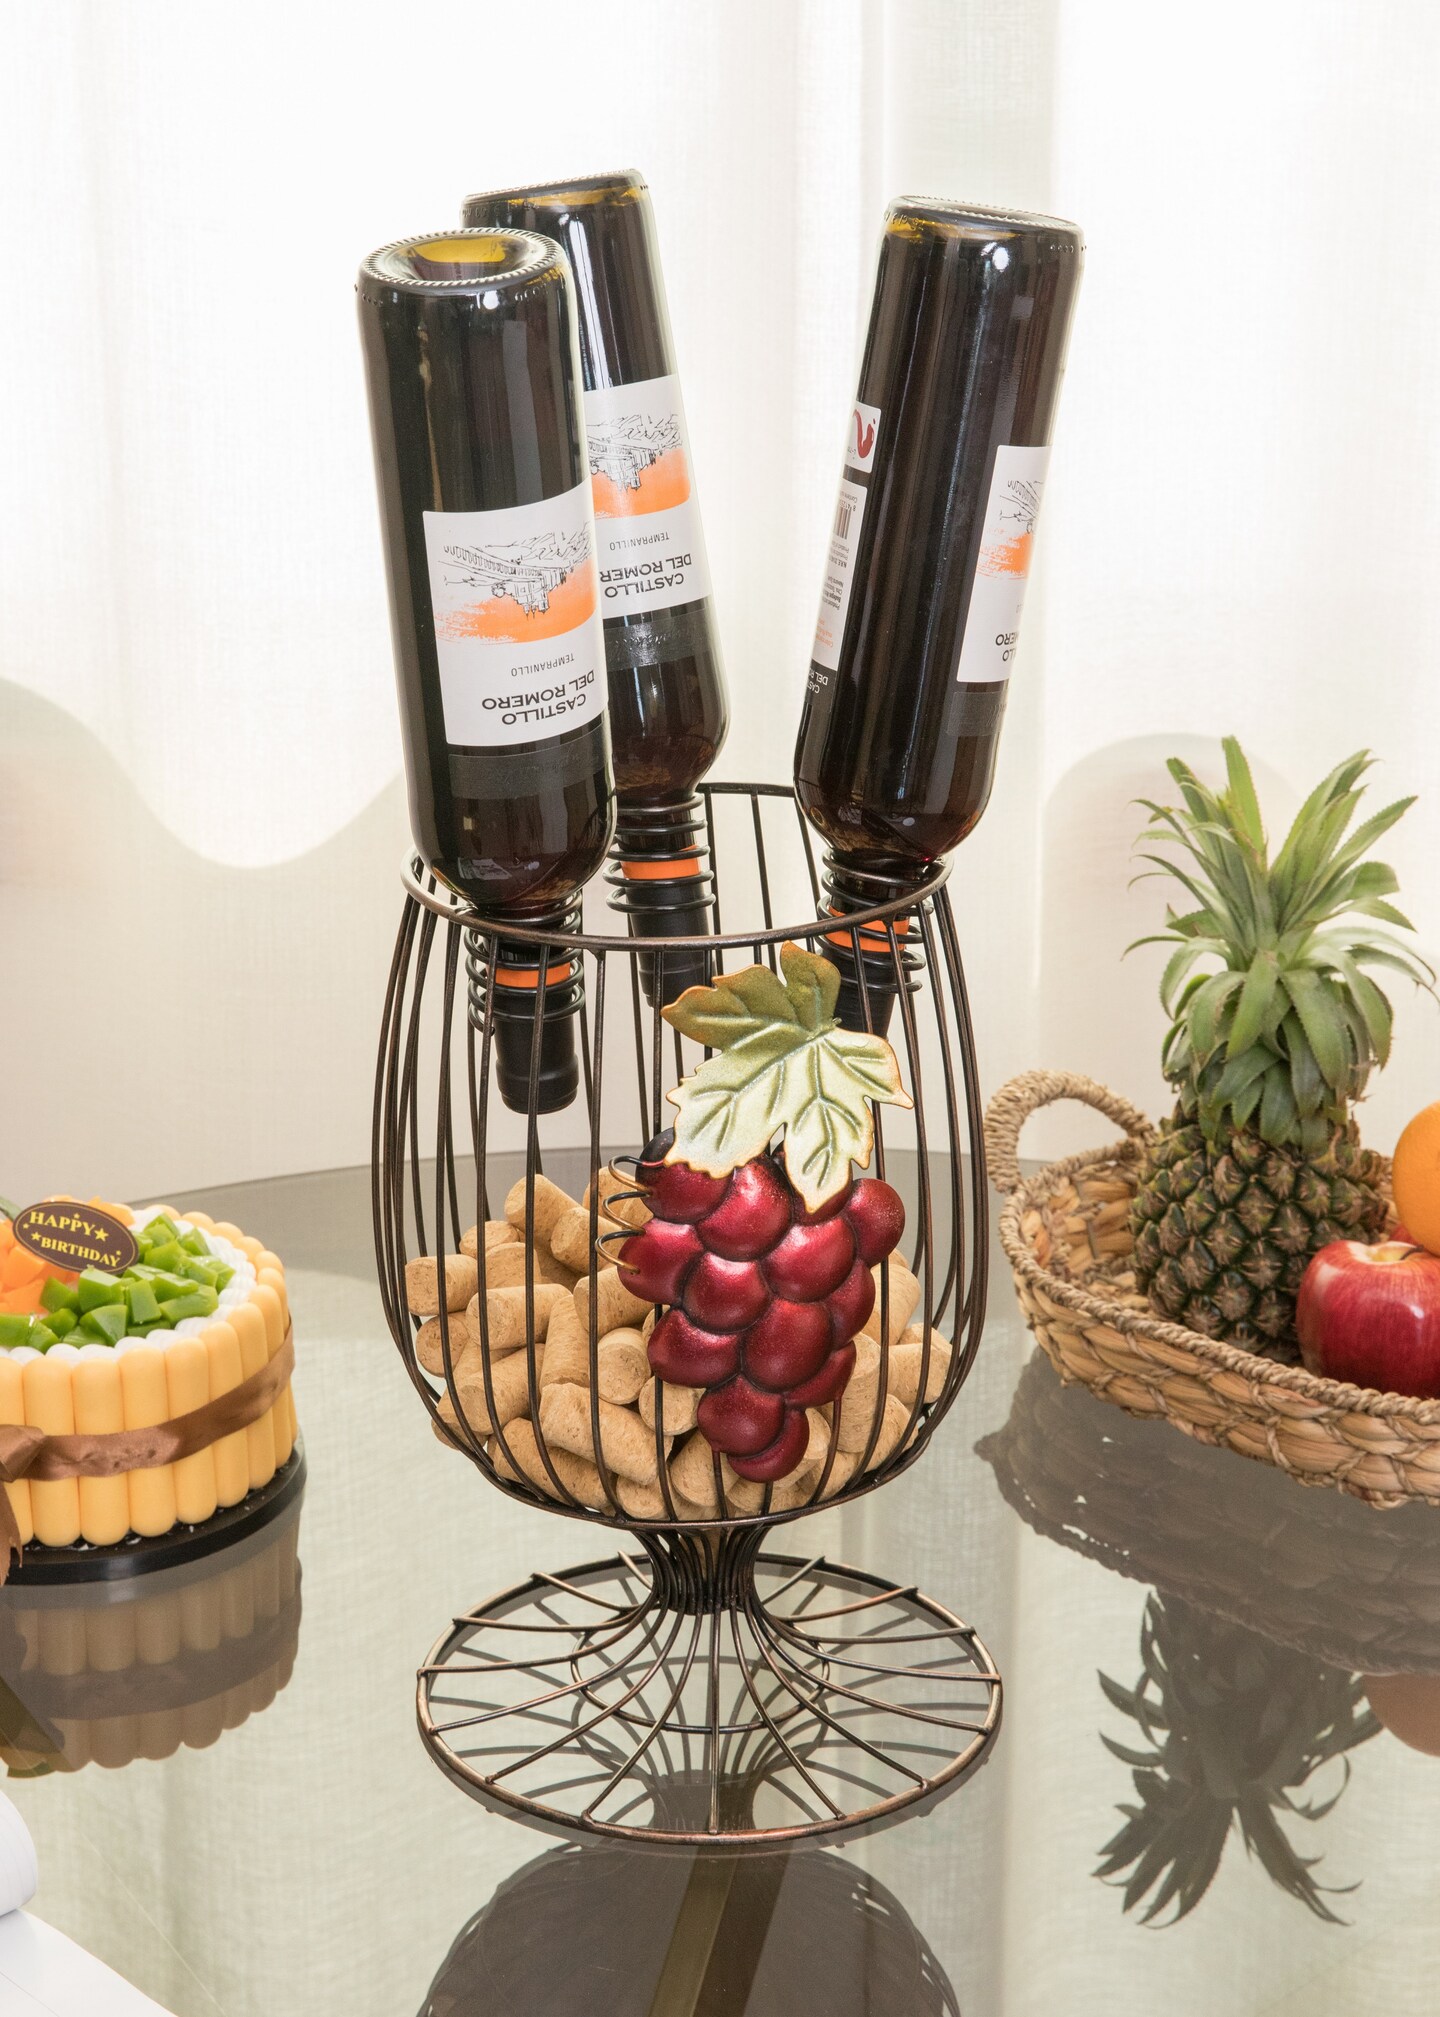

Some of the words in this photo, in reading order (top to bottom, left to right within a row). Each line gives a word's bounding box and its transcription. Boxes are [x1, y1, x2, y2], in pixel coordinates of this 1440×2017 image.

[610, 532, 669, 550] TEMPRANILLO
[666, 554, 691, 570] DEL
[604, 573, 684, 598] CASTILLO
[511, 653, 574, 678] TEMPRANILLO
[569, 669, 595, 691] DEL
[482, 684, 566, 710] ROMERO
[502, 694, 586, 725] CASTILLO
[29, 1211, 95, 1236] HAPPY
[41, 1237, 121, 1268] BIRTHDAY
